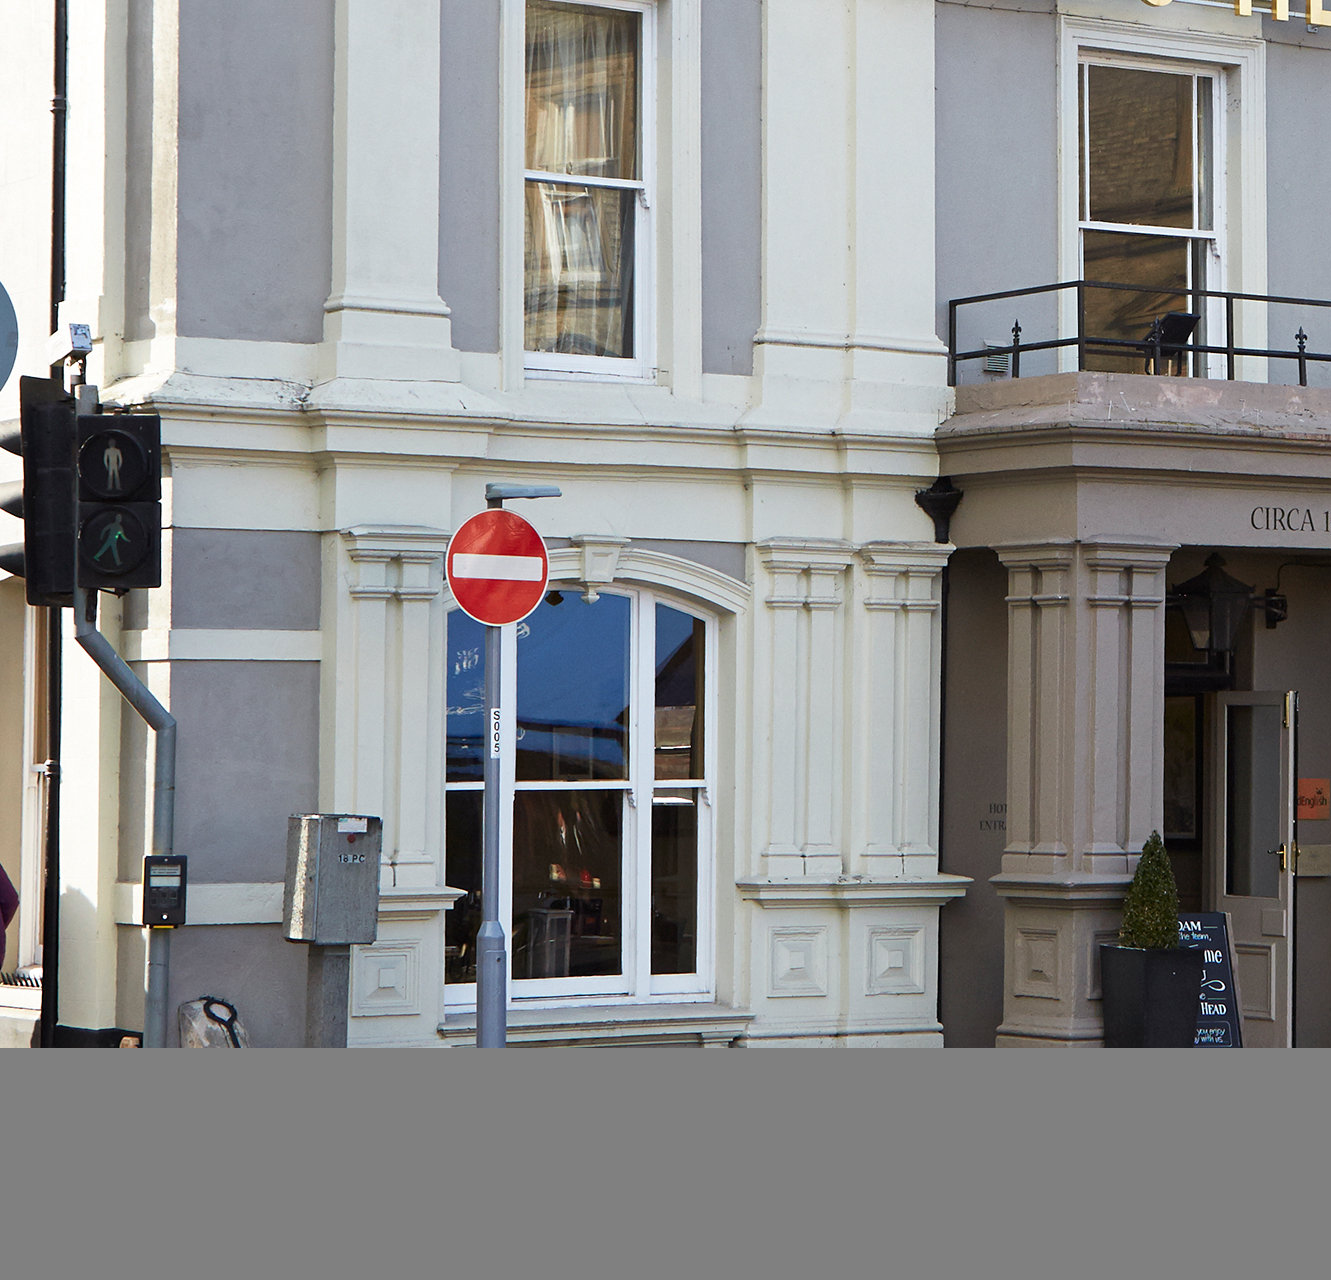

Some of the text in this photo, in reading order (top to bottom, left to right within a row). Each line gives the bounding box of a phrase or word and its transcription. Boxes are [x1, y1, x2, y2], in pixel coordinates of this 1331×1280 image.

[1250, 505, 1316, 532] CIRCA
[492, 710, 500, 753] S005
[989, 803, 1007, 814] HOT
[352, 854, 365, 863] PC
[1200, 1002, 1227, 1015] HEAD
